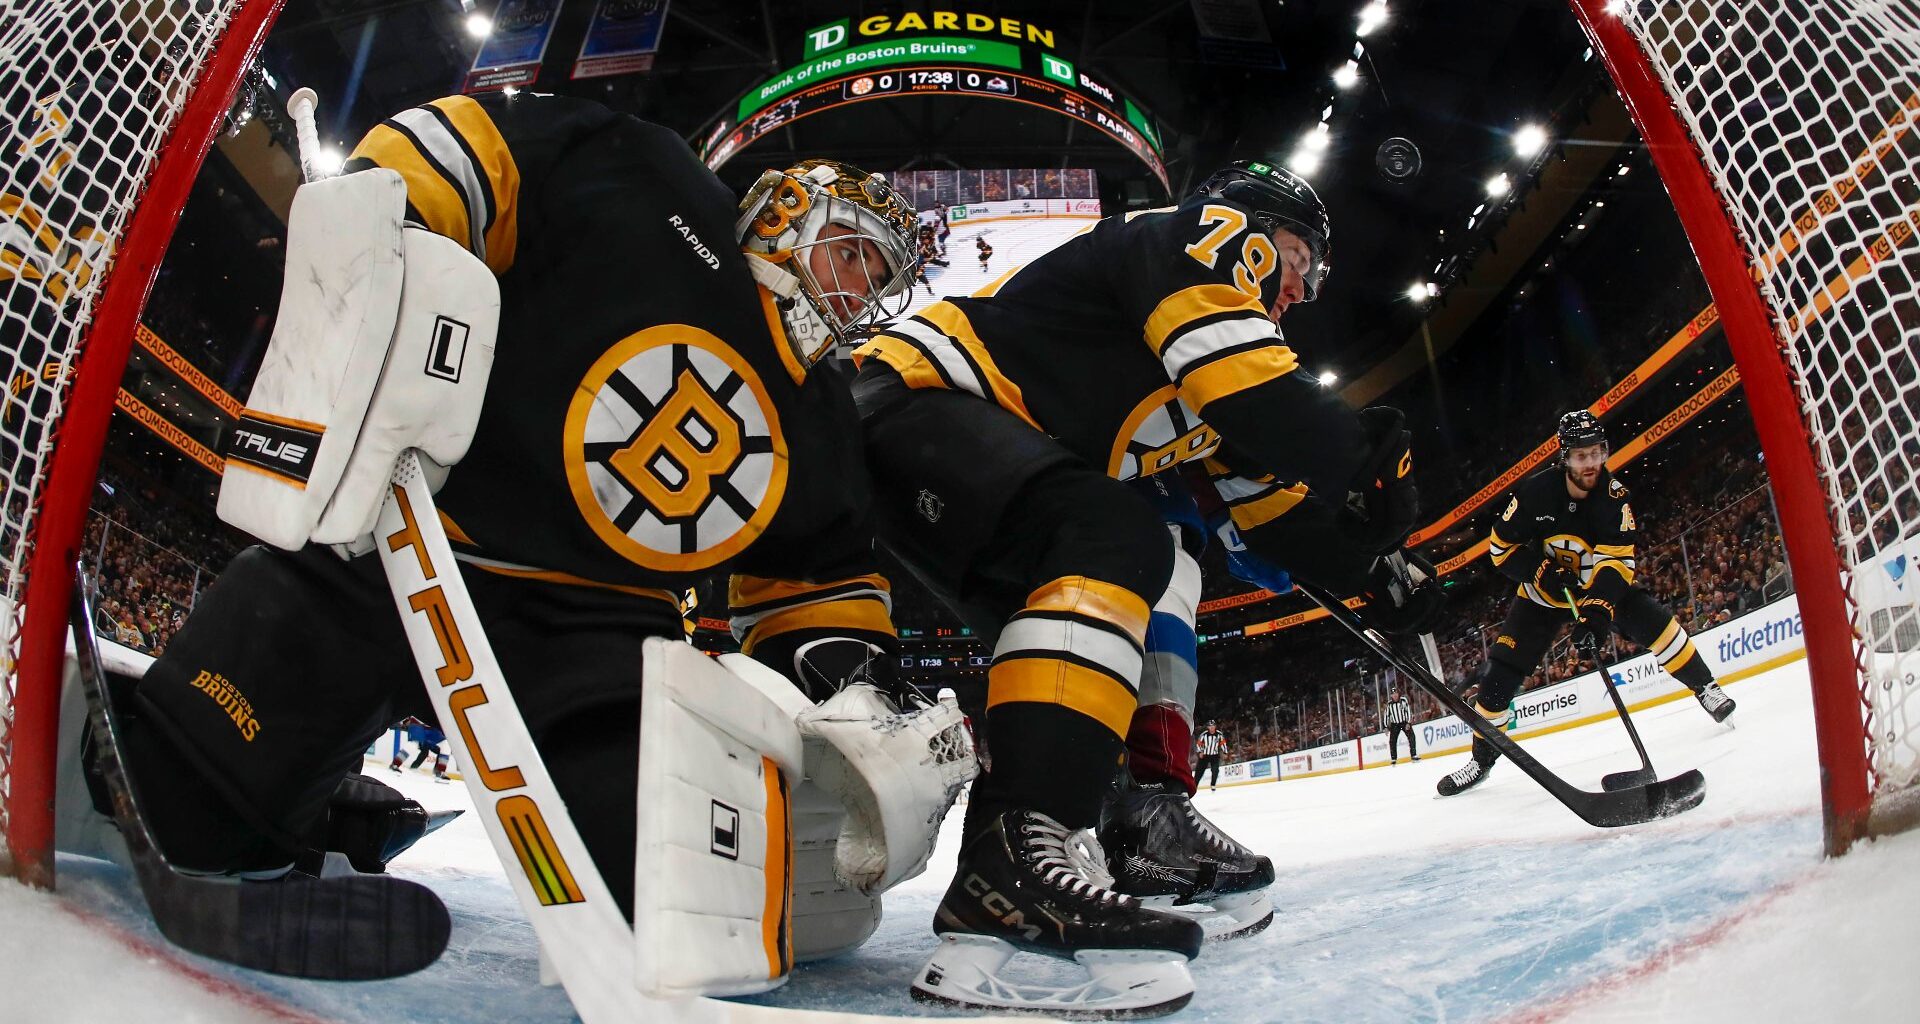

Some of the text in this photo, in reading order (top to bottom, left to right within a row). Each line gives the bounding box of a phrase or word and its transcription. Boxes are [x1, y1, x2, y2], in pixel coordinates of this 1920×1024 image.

[809, 11, 1055, 51] TD GARDEN
[761, 74, 794, 99] Bank
[797, 64, 813, 79] of
[816, 57, 842, 73] the
[845, 45, 906, 64] Boston
[880, 75, 892, 88] 0
[908, 71, 954, 84] 17:38
[967, 73, 980, 87] 0
[1045, 58, 1114, 102] TD Bank
[1253, 163, 1295, 187] TD Bank
[1185, 204, 1277, 300] 79
[1606, 373, 1639, 405] KYOCERA
[235, 430, 308, 464] TRUE
[1619, 503, 1636, 531] 18
[1275, 613, 1305, 628] KYOCERA
[920, 659, 942, 667] 17:38
[190, 669, 261, 742] BRUINS
[213, 673, 254, 716] BOSTON
[387, 483, 586, 906] TRUE
[1338, 747, 1349, 756] LAW
[963, 872, 1043, 941] CCM
